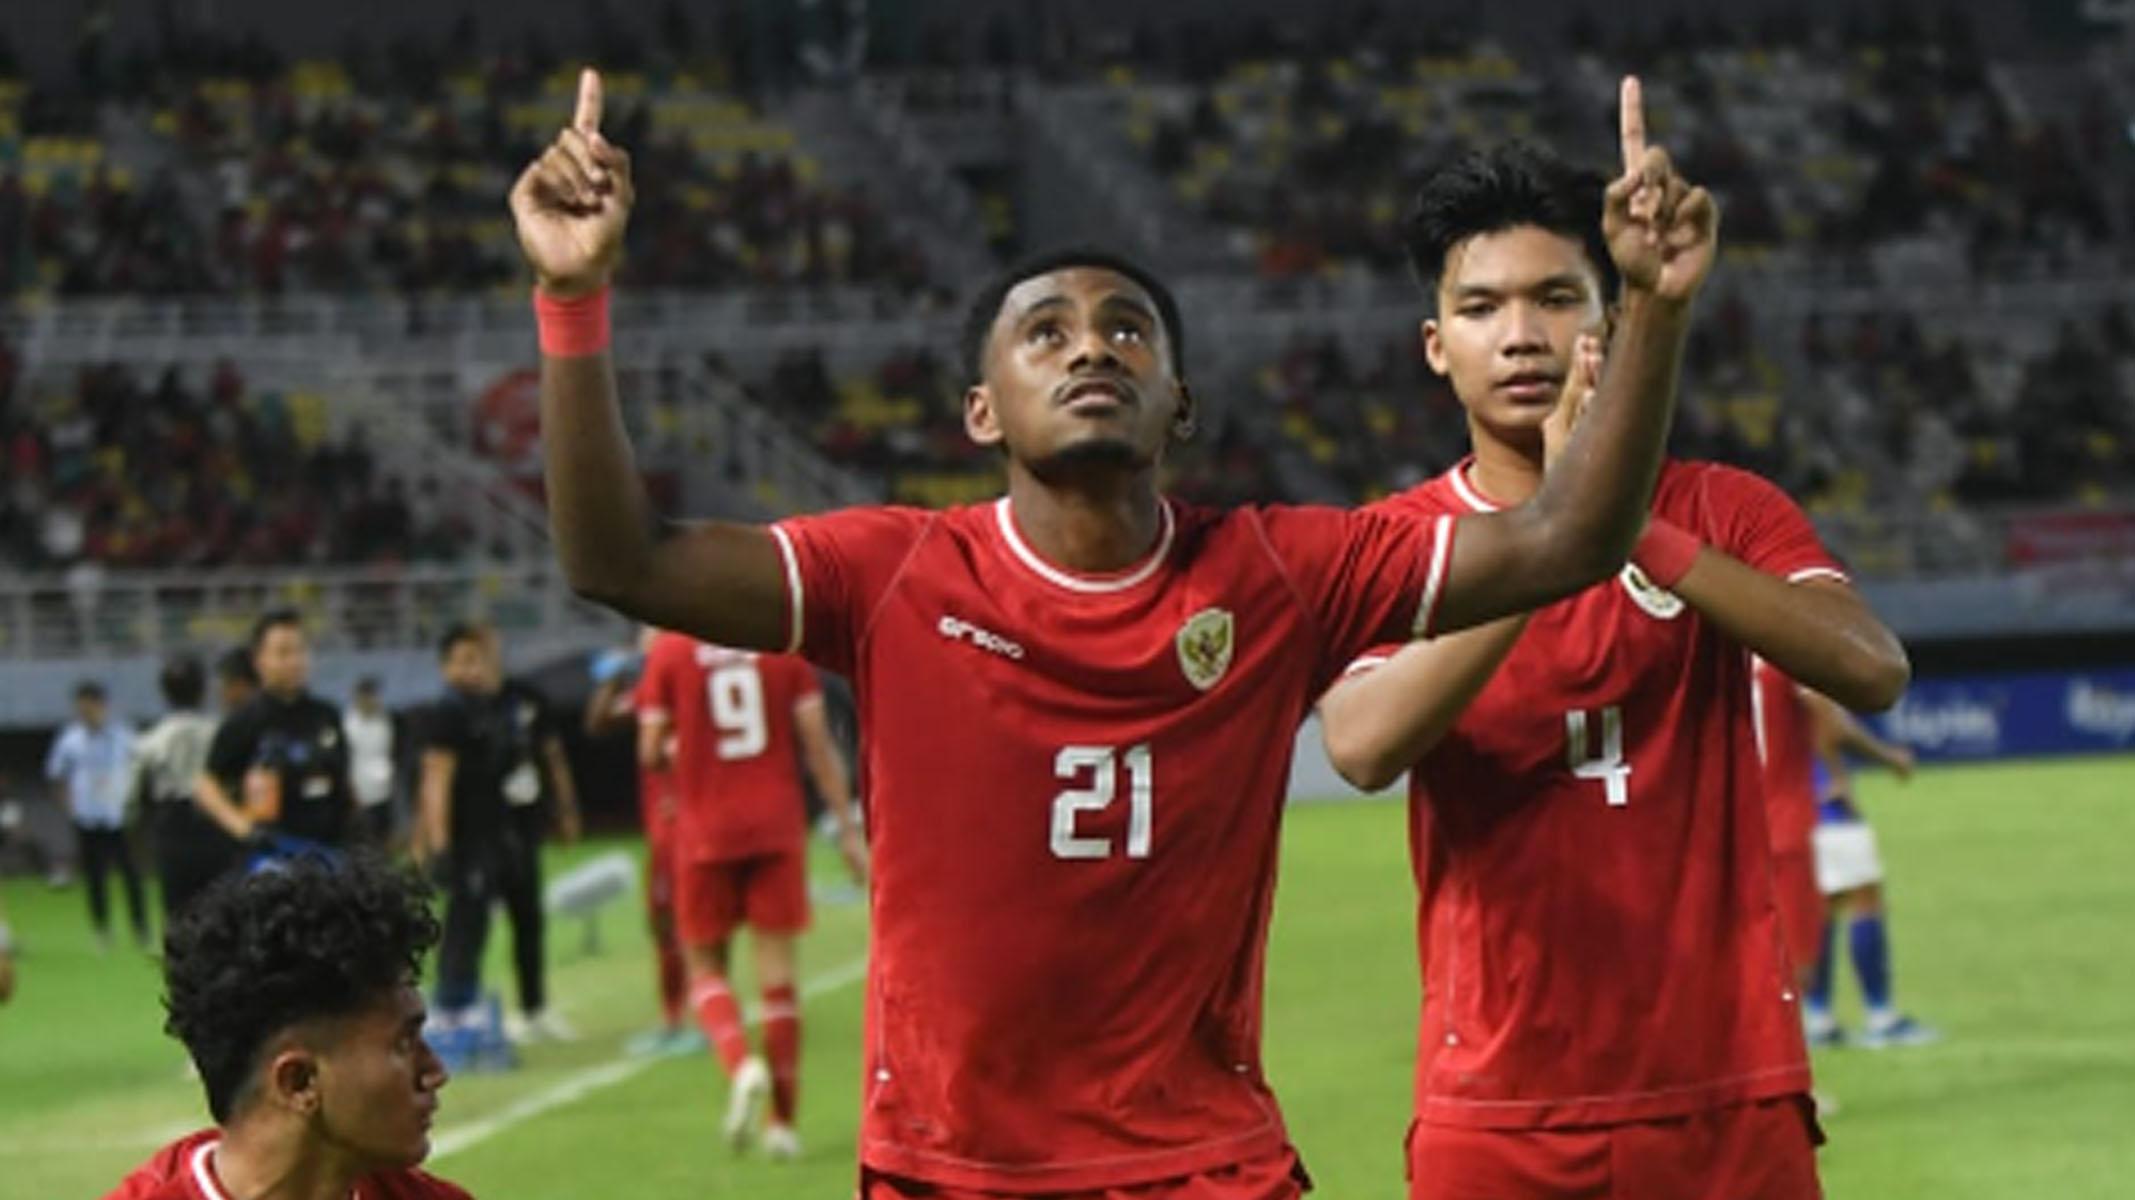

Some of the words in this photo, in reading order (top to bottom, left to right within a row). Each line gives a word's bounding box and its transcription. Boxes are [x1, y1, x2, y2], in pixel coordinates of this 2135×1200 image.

[708, 665, 769, 760] 9
[1565, 706, 1632, 805] 4
[1050, 744, 1152, 858] 21
